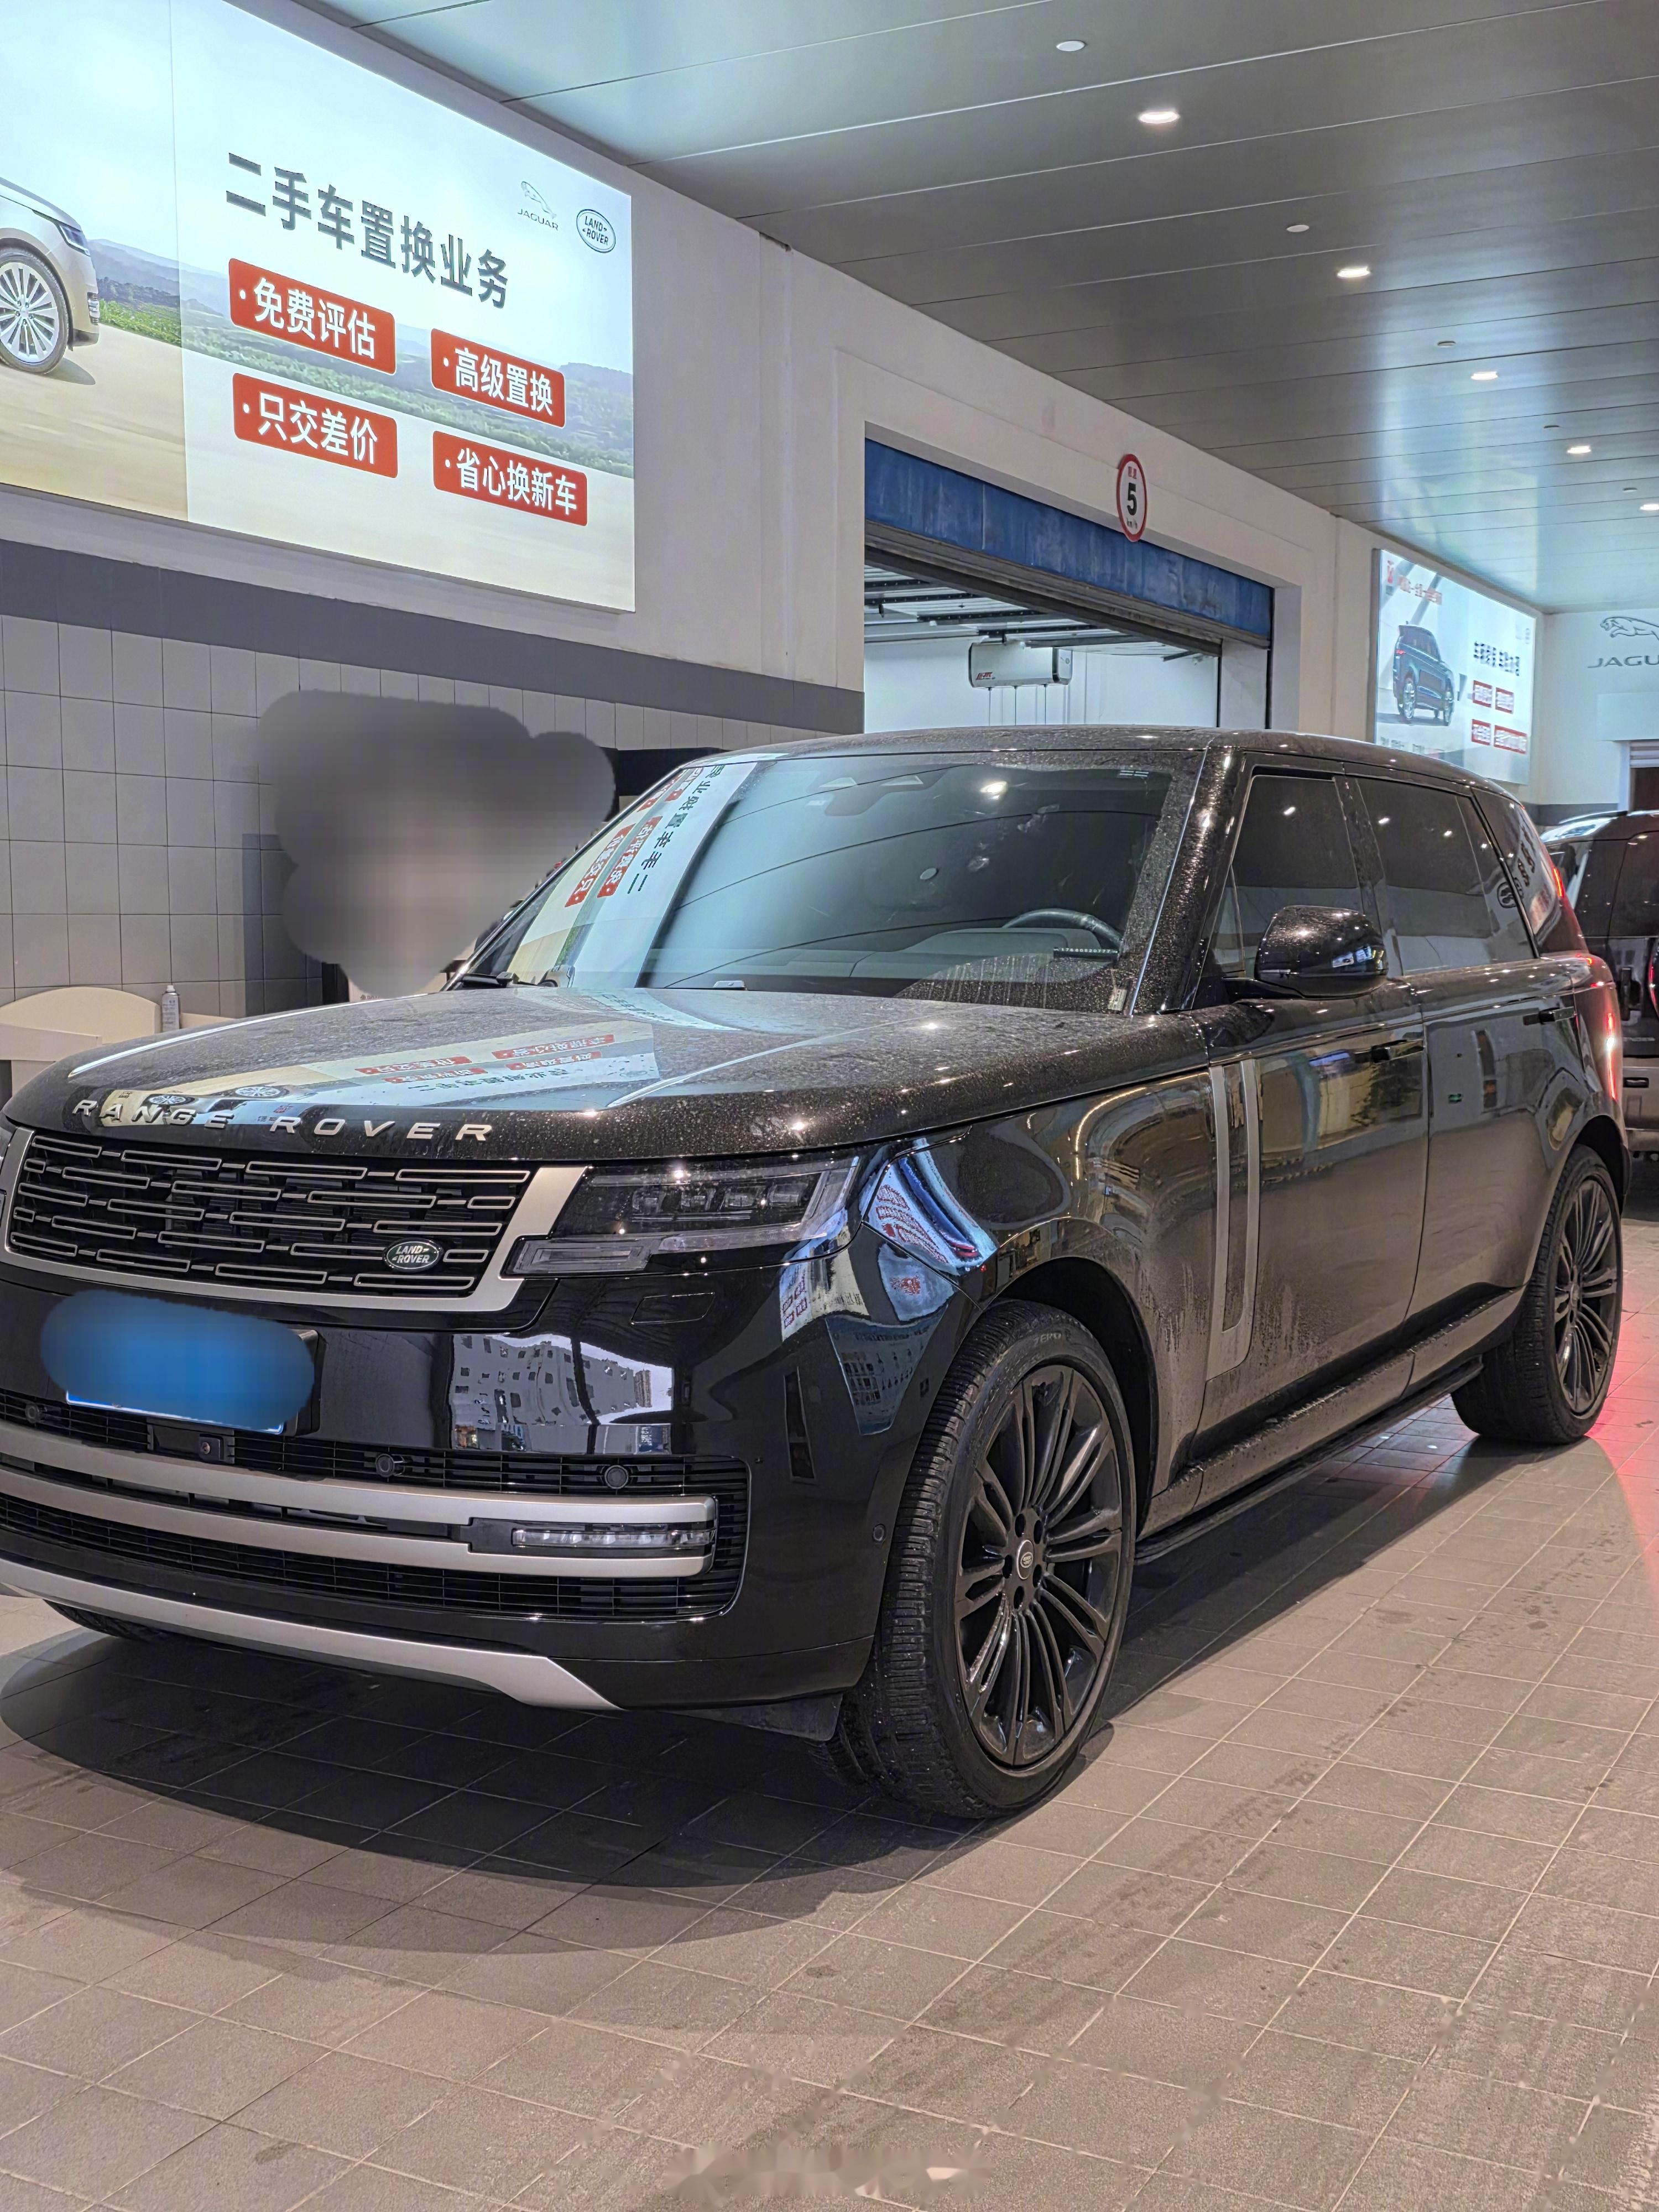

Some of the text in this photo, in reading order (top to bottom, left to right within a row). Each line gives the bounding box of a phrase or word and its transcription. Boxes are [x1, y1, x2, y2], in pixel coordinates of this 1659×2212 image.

[226, 153, 508, 309] 二手车置换业务
[518, 209, 558, 231] JAGUAR
[585, 216, 603, 232] LAND
[586, 228, 608, 246] ROVER
[254, 278, 375, 359] 免费评估
[455, 347, 553, 416] 高级置换
[258, 393, 377, 465] 只交差价
[456, 447, 577, 515] 省心换新车
[1127, 483, 1137, 515] 5
[72, 1100, 493, 1141] RANGE ROVER
[396, 1245, 423, 1254] LAND
[397, 1254, 430, 1263] ROVER
